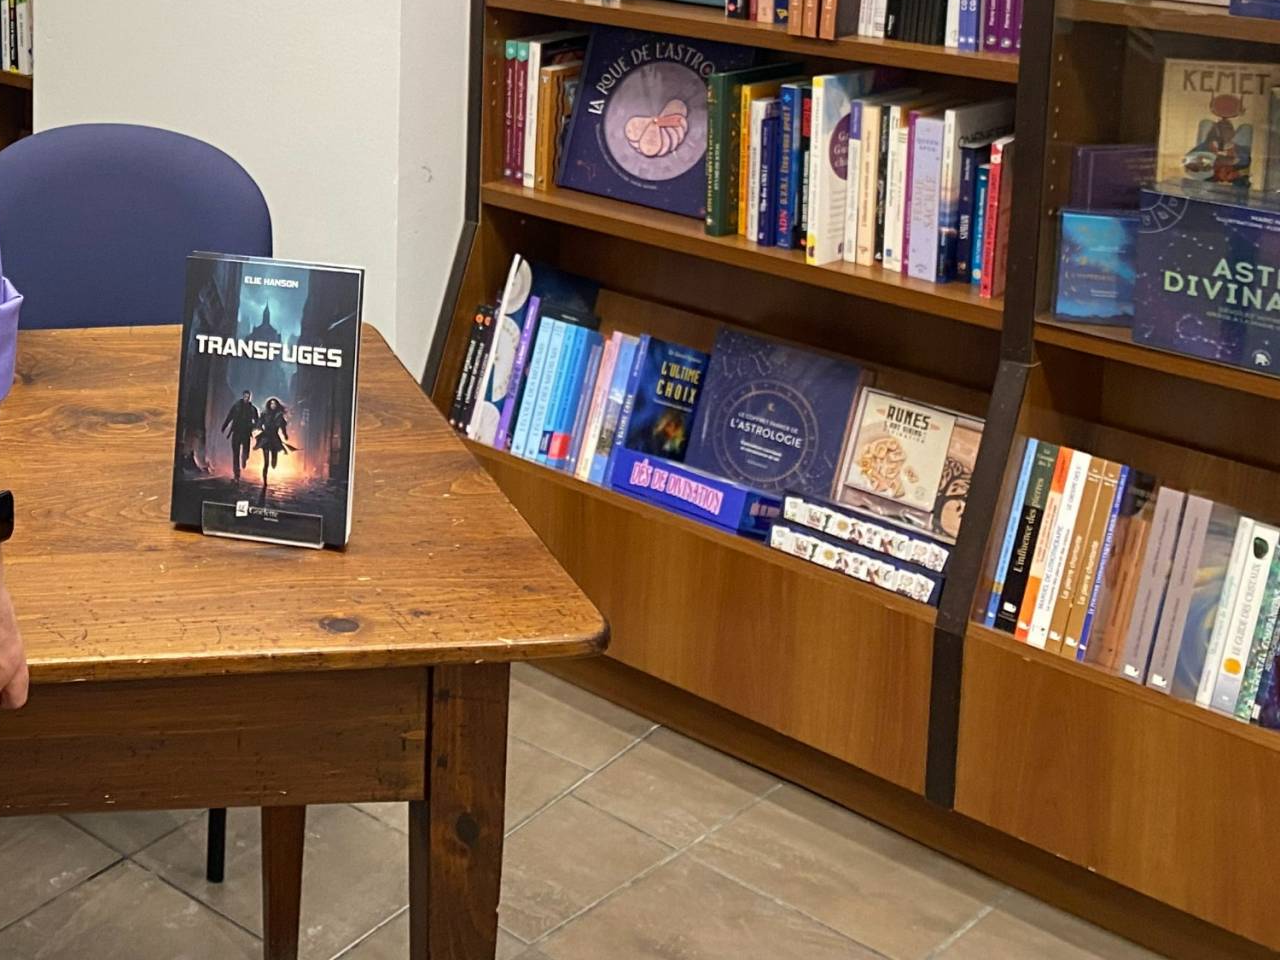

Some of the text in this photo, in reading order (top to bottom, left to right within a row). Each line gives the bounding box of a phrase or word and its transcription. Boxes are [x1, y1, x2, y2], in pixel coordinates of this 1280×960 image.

[588, 99, 605, 116] LA
[631, 46, 651, 64] DE
[655, 42, 718, 78] L'ASTRO
[1182, 69, 1271, 95] KEMET
[244, 275, 299, 289] ELIE HANSON
[1212, 258, 1280, 290] AST
[1163, 270, 1280, 312] DIVINA
[195, 334, 343, 368] TRANSFUGES
[661, 360, 701, 385] L'ULTIME
[656, 380, 697, 405] CHOIX
[730, 417, 804, 449] L'ASTROLOGIE
[886, 405, 931, 431] RUNES
[630, 458, 724, 516] DÉS DE DIVINATION
[1013, 477, 1045, 573] L'influence des pierres
